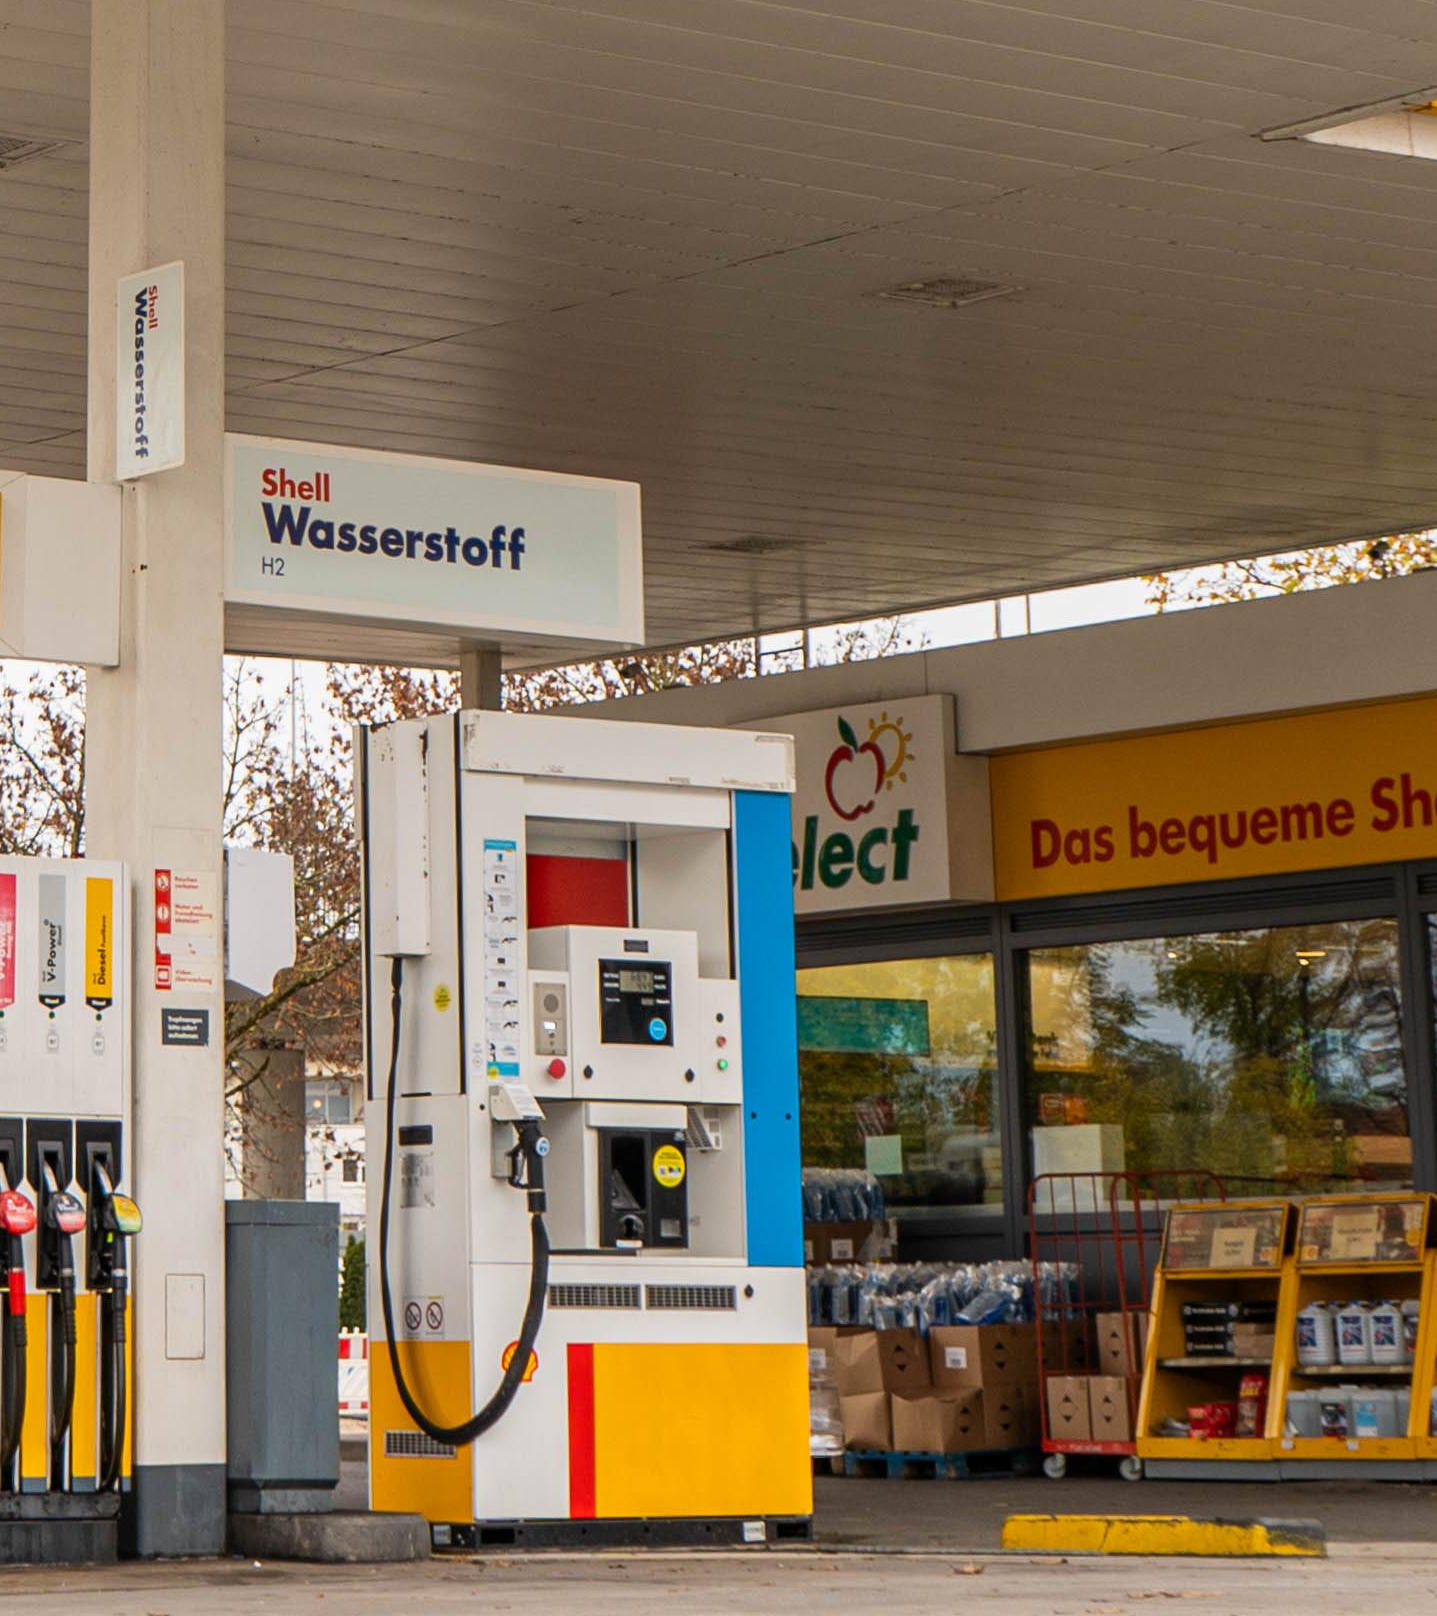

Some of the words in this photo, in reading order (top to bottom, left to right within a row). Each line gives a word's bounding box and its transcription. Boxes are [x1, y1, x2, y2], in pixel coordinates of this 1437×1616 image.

[148, 284, 159, 330] Shell
[133, 288, 149, 460] Wasserstoff
[261, 468, 331, 503] Shell
[261, 502, 526, 572] Wasserstoff
[261, 556, 286, 577] H2
[792, 808, 920, 890] lect
[1031, 816, 1115, 870] Das
[1128, 790, 1356, 866] bequeme
[47, 922, 57, 982] V-Power
[97, 948, 107, 985] Diesel
